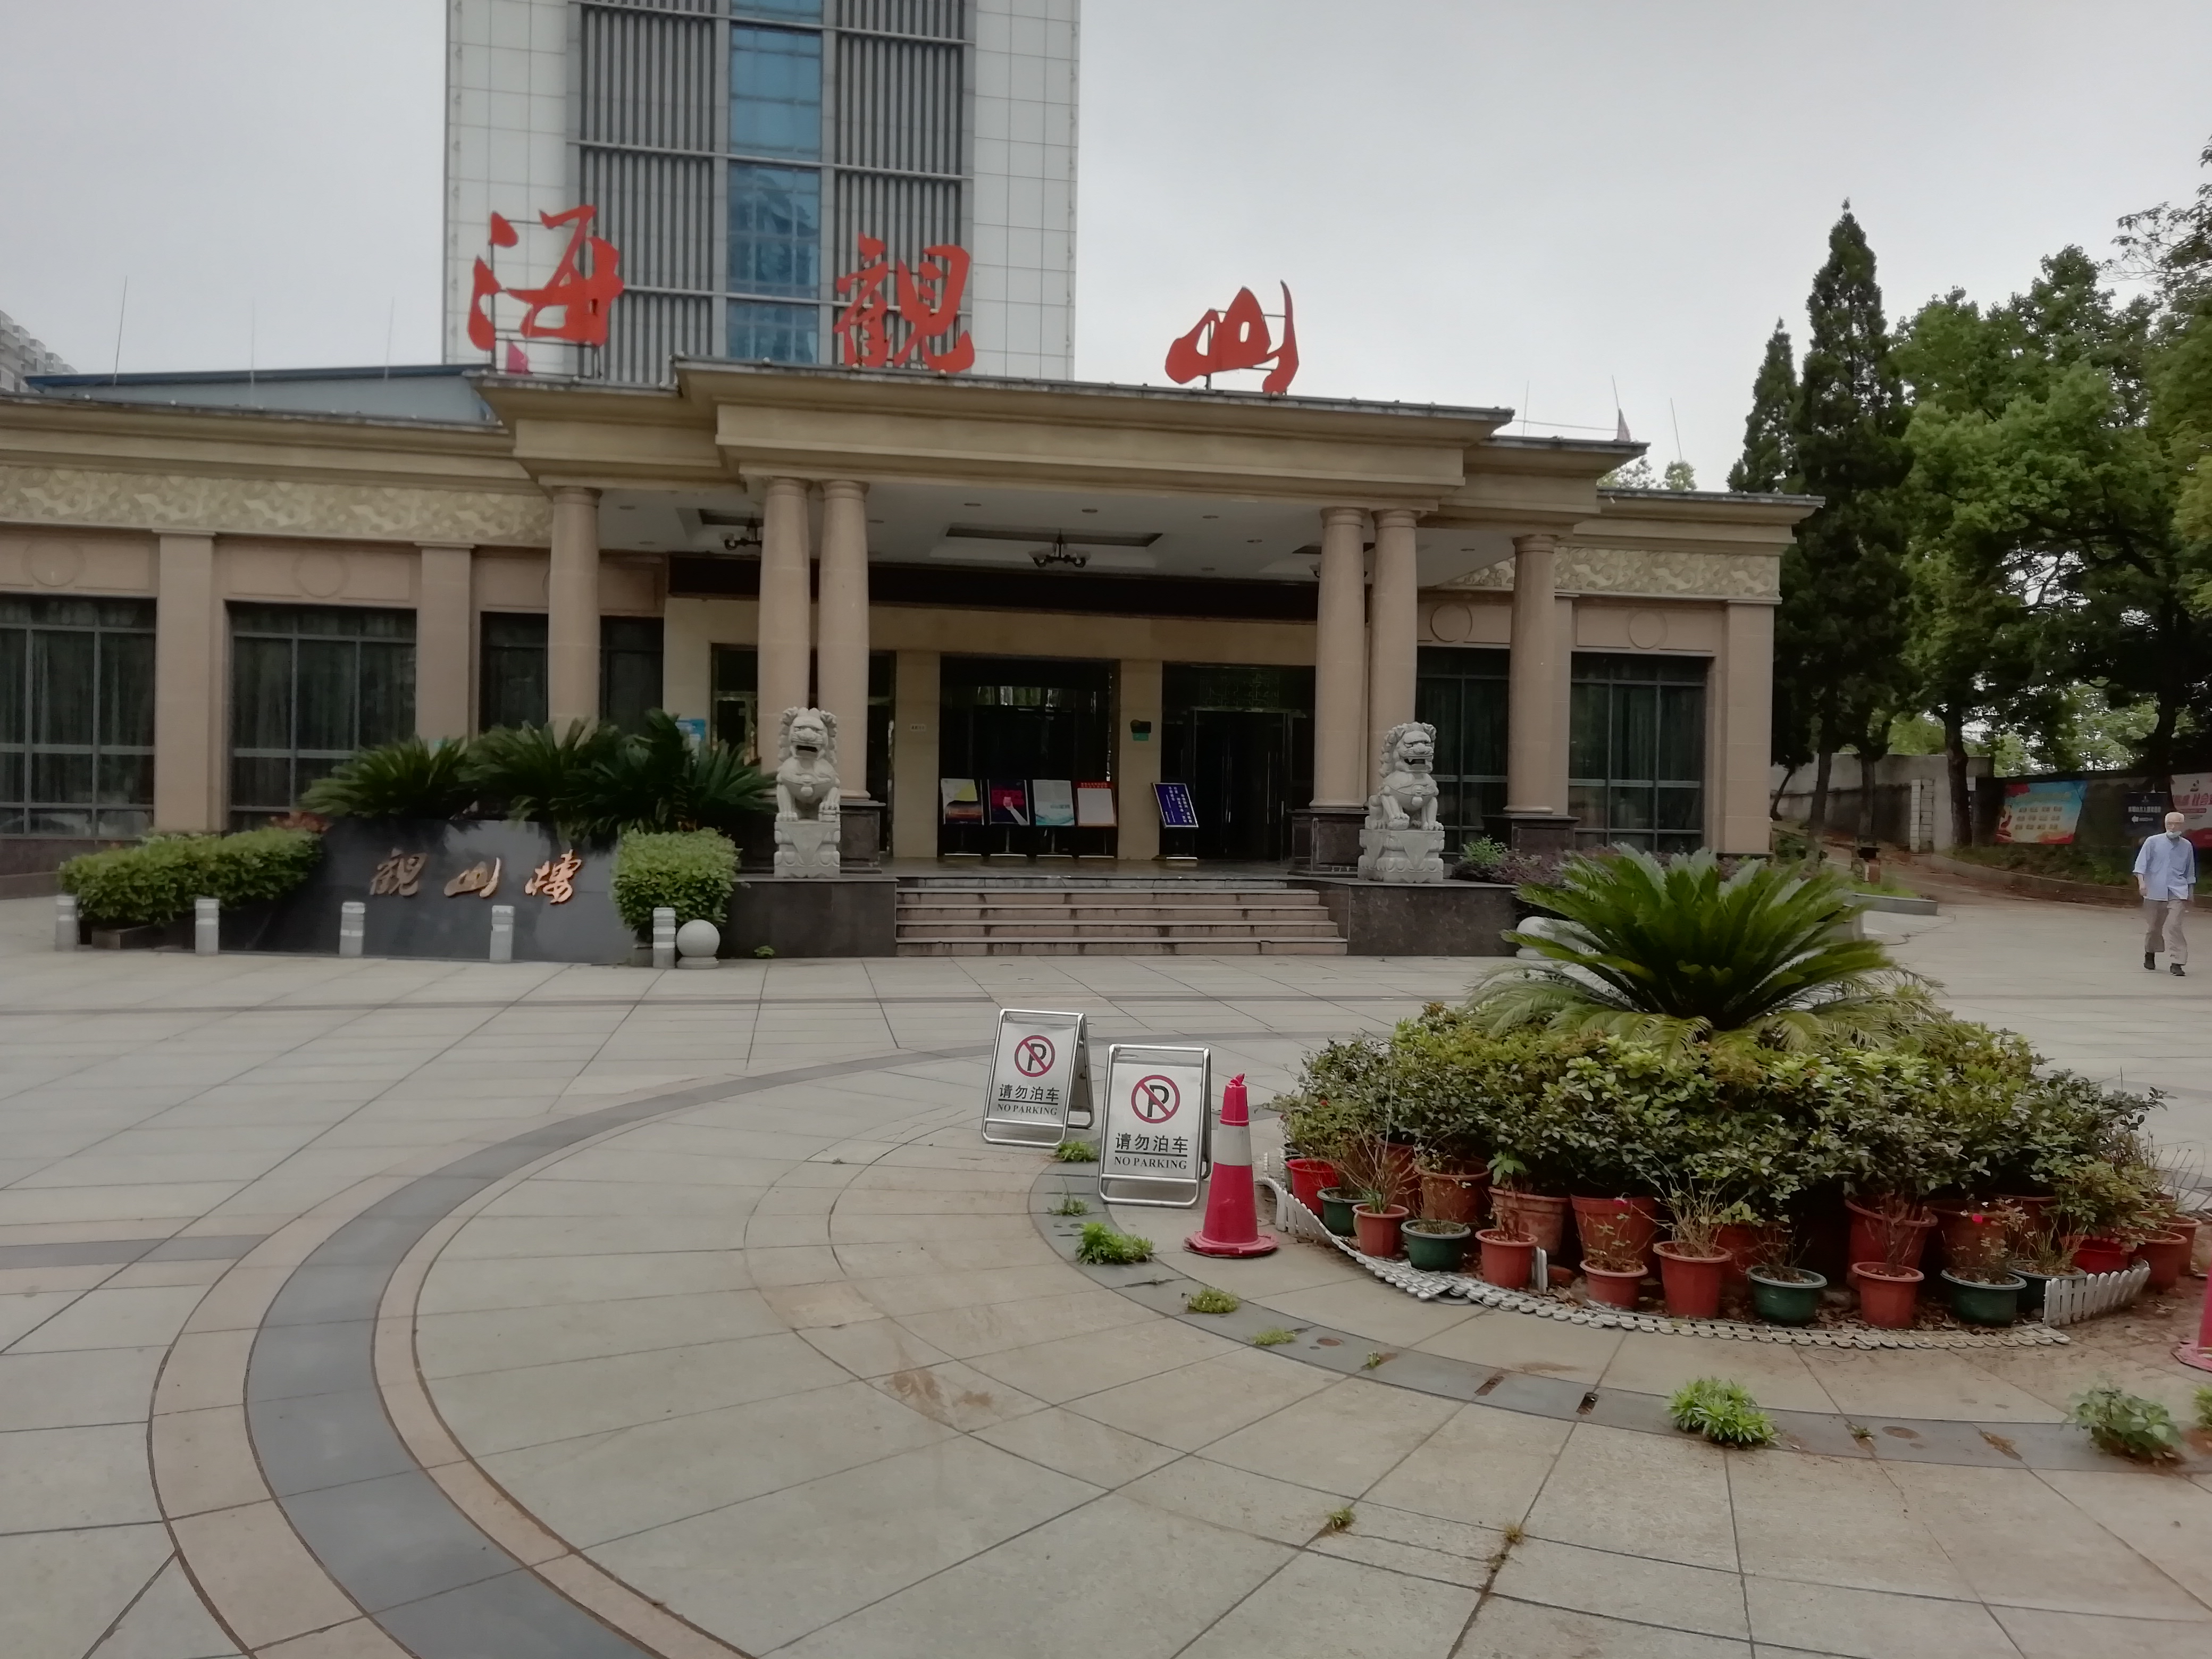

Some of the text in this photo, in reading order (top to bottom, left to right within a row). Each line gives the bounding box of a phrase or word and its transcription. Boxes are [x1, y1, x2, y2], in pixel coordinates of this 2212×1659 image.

[999, 1084, 1060, 1102] 请勿泊车
[997, 1103, 1058, 1116] NO PARKING
[1116, 1133, 1188, 1153] 请勿泊车
[1114, 1156, 1187, 1170] NO PARKING
